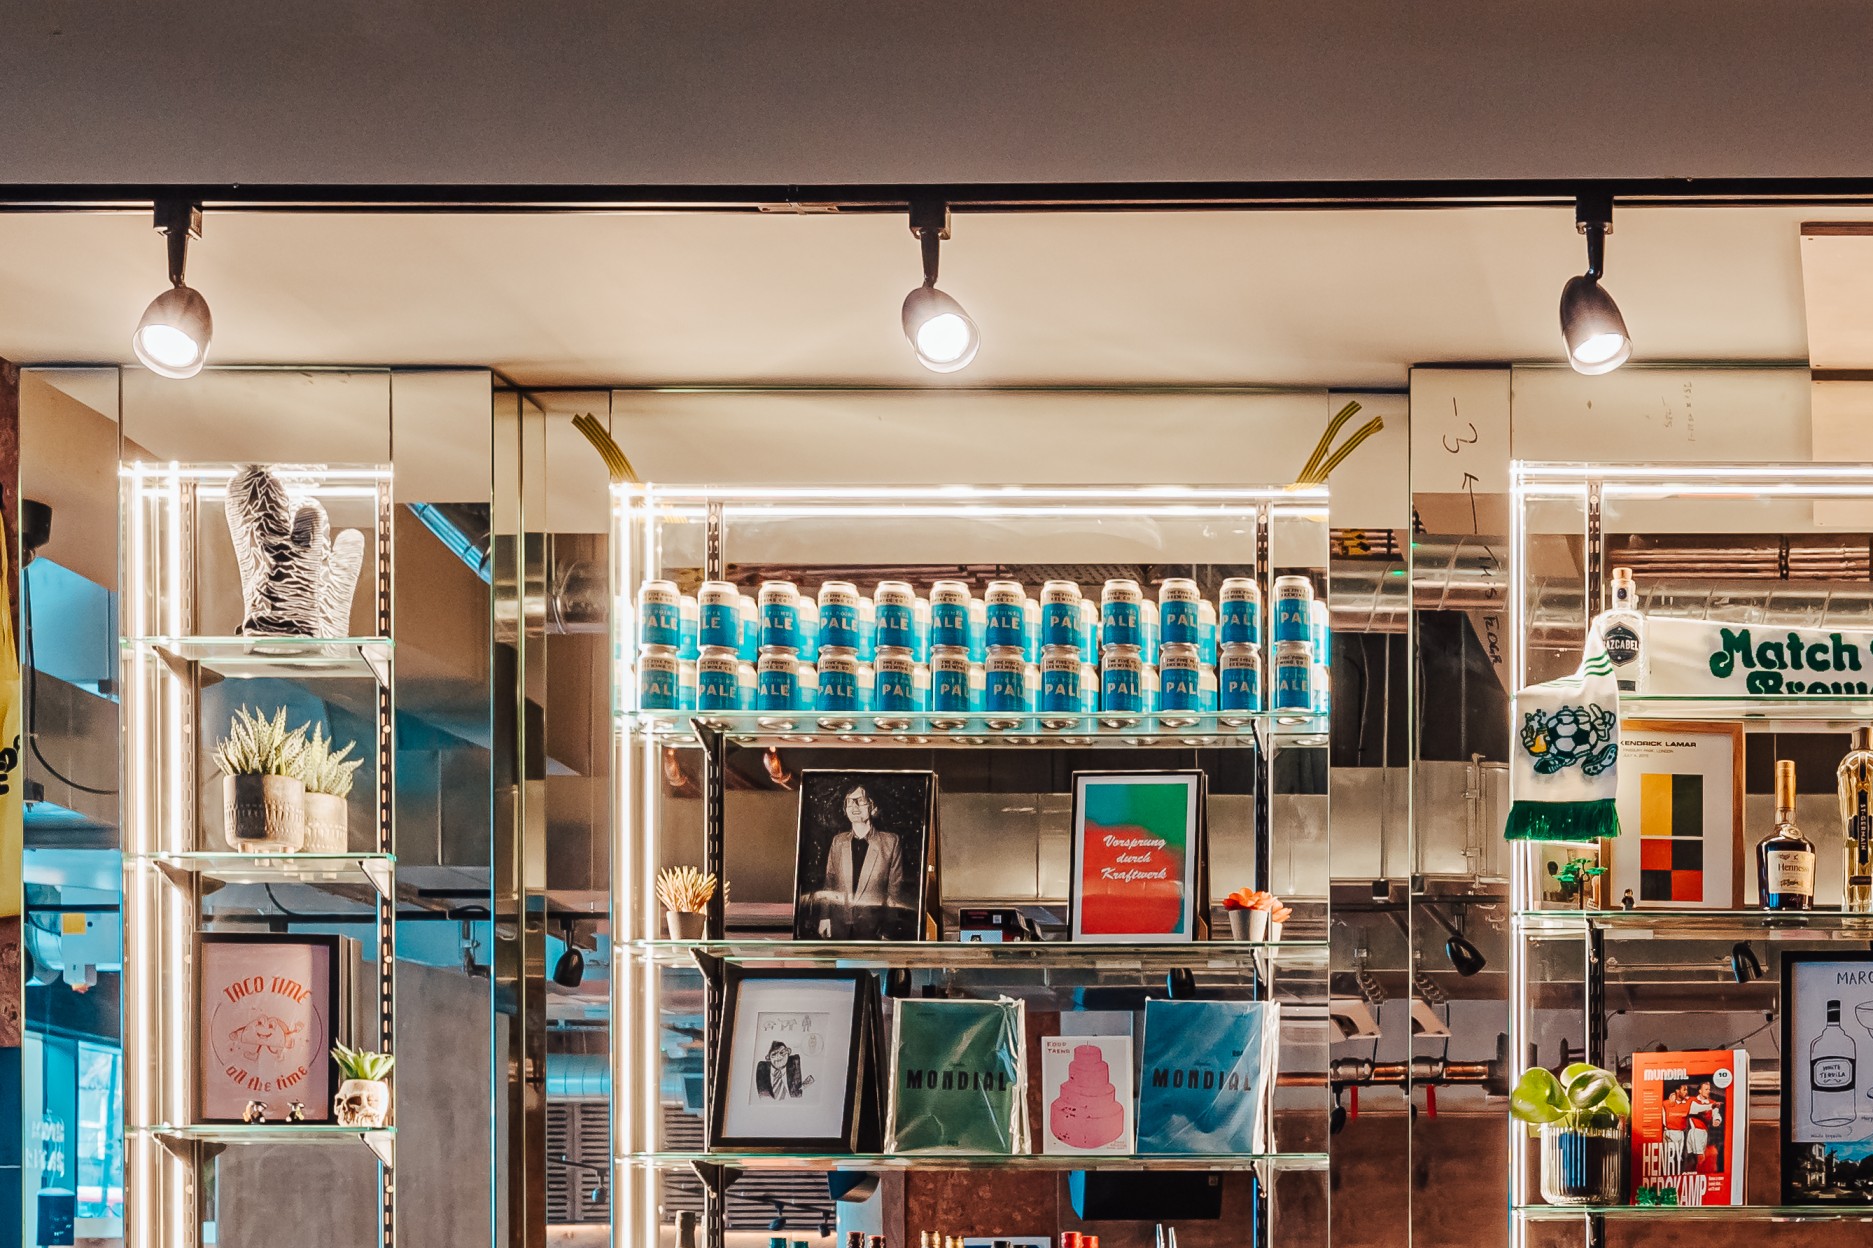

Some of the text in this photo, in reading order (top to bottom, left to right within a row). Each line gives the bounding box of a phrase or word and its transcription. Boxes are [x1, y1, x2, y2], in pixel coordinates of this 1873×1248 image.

[1709, 627, 1862, 678] Match
[1103, 834, 1167, 850] Vorsprung
[1116, 851, 1152, 863] durch
[1101, 867, 1167, 883] Kraftwerk
[223, 976, 312, 1004] TACO TIME
[226, 1065, 308, 1092] all the time
[906, 1069, 1007, 1091] MONDIAL
[1152, 1068, 1252, 1091] MONDIAL
[1643, 1068, 1688, 1081] MUNDIAL
[1643, 1142, 1683, 1177] HENRY
